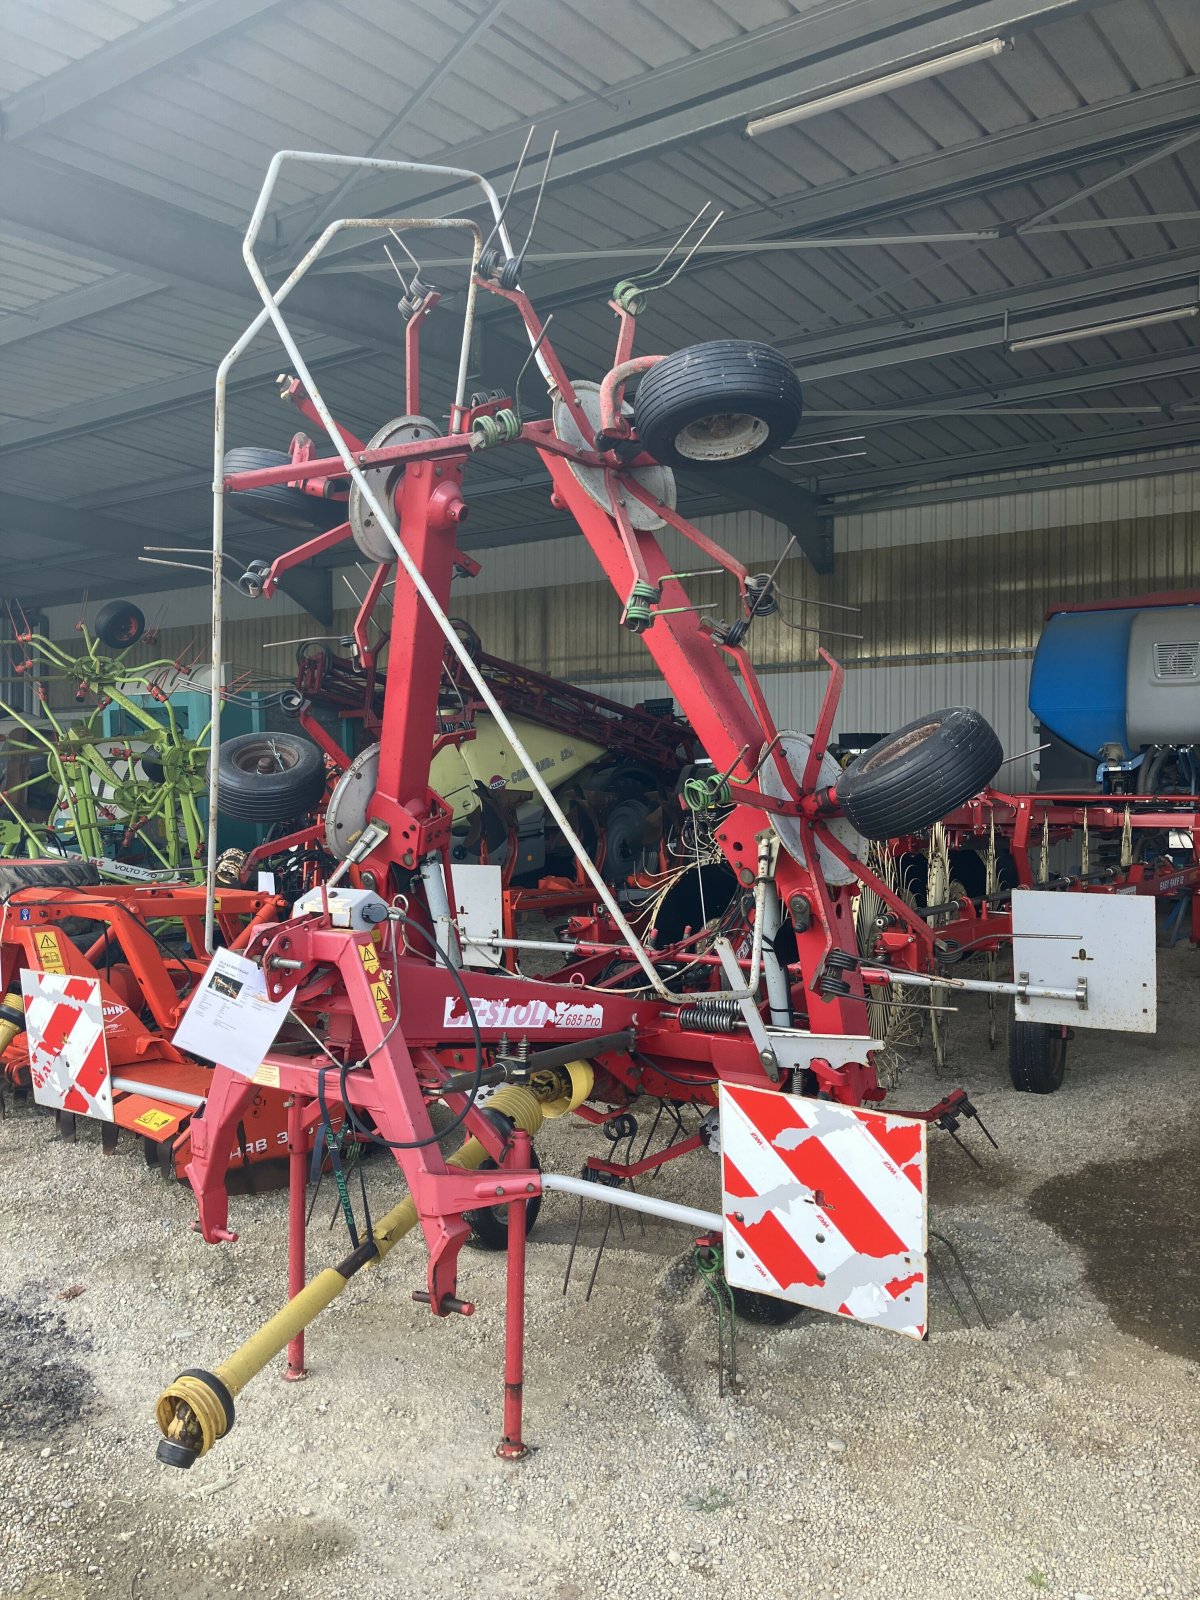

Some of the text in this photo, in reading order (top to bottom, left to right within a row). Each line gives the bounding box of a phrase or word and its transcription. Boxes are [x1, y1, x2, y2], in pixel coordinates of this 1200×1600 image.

[114, 864, 140, 876] VOLTO
[565, 1013, 584, 1026] 685
[584, 1014, 601, 1027] Pro
[229, 1138, 268, 1160] HRB
[335, 1170, 350, 1210] CORDEX
